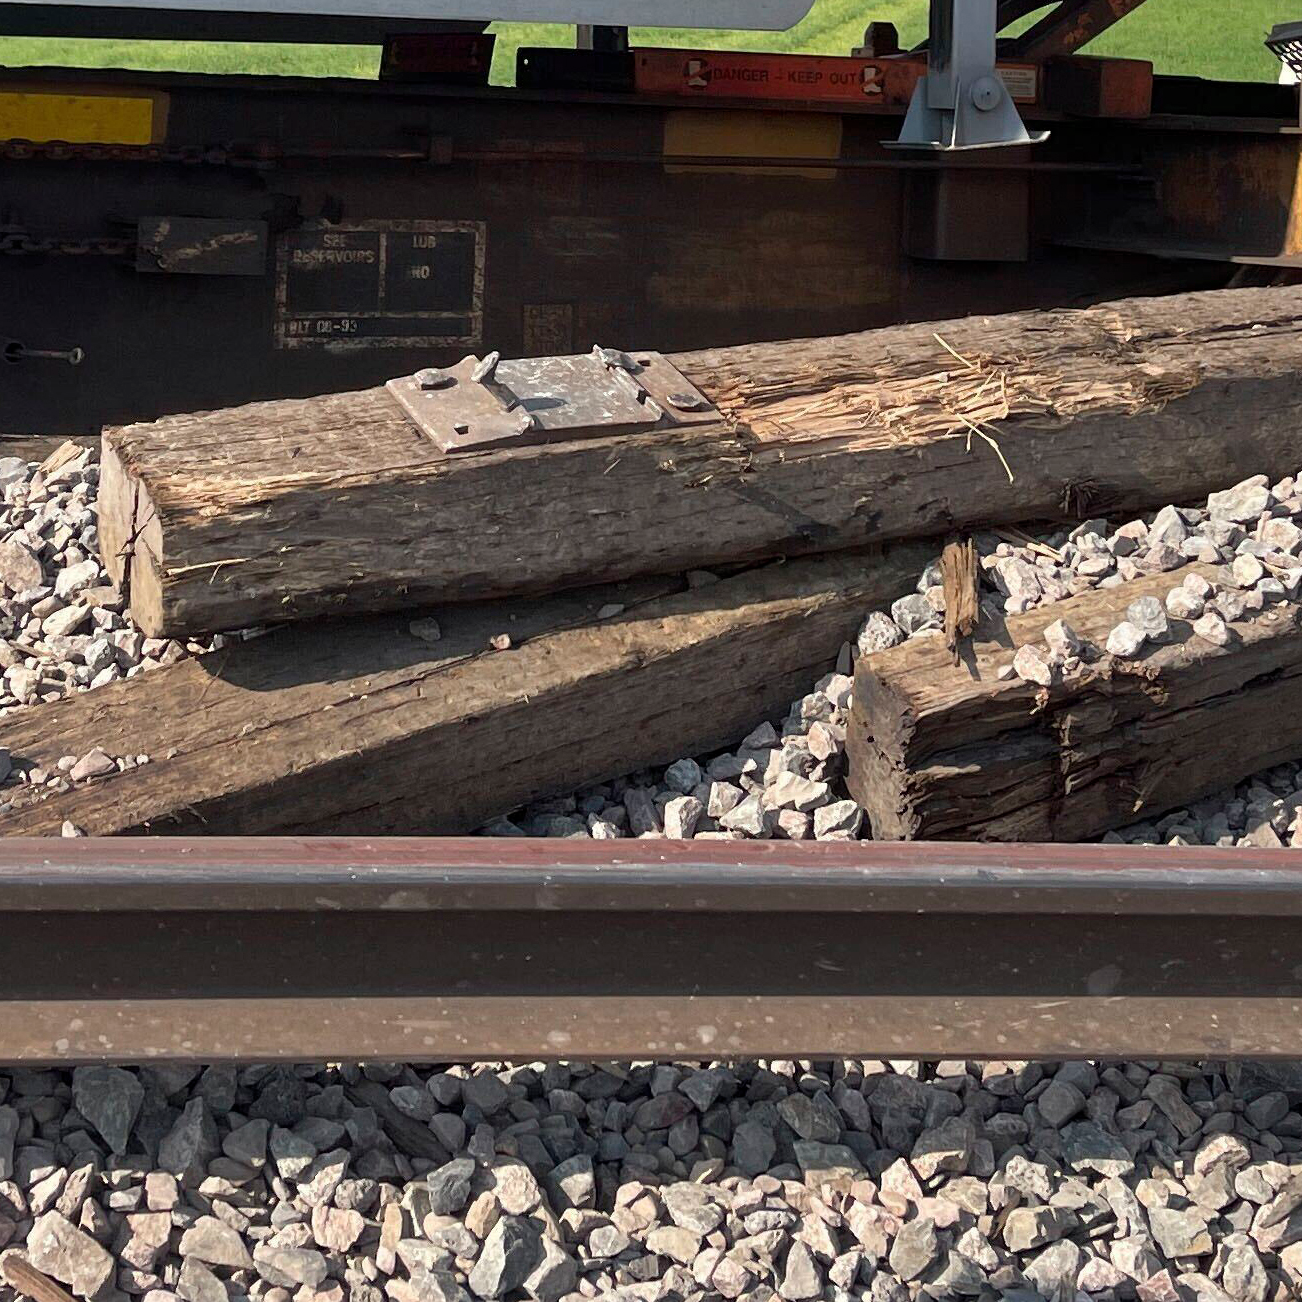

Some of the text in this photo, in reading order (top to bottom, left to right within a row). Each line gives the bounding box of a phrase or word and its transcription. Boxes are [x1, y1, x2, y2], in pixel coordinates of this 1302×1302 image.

[713, 68, 769, 82] DANGER
[787, 72, 823, 84] KEEP
[829, 72, 856, 86] OUT
